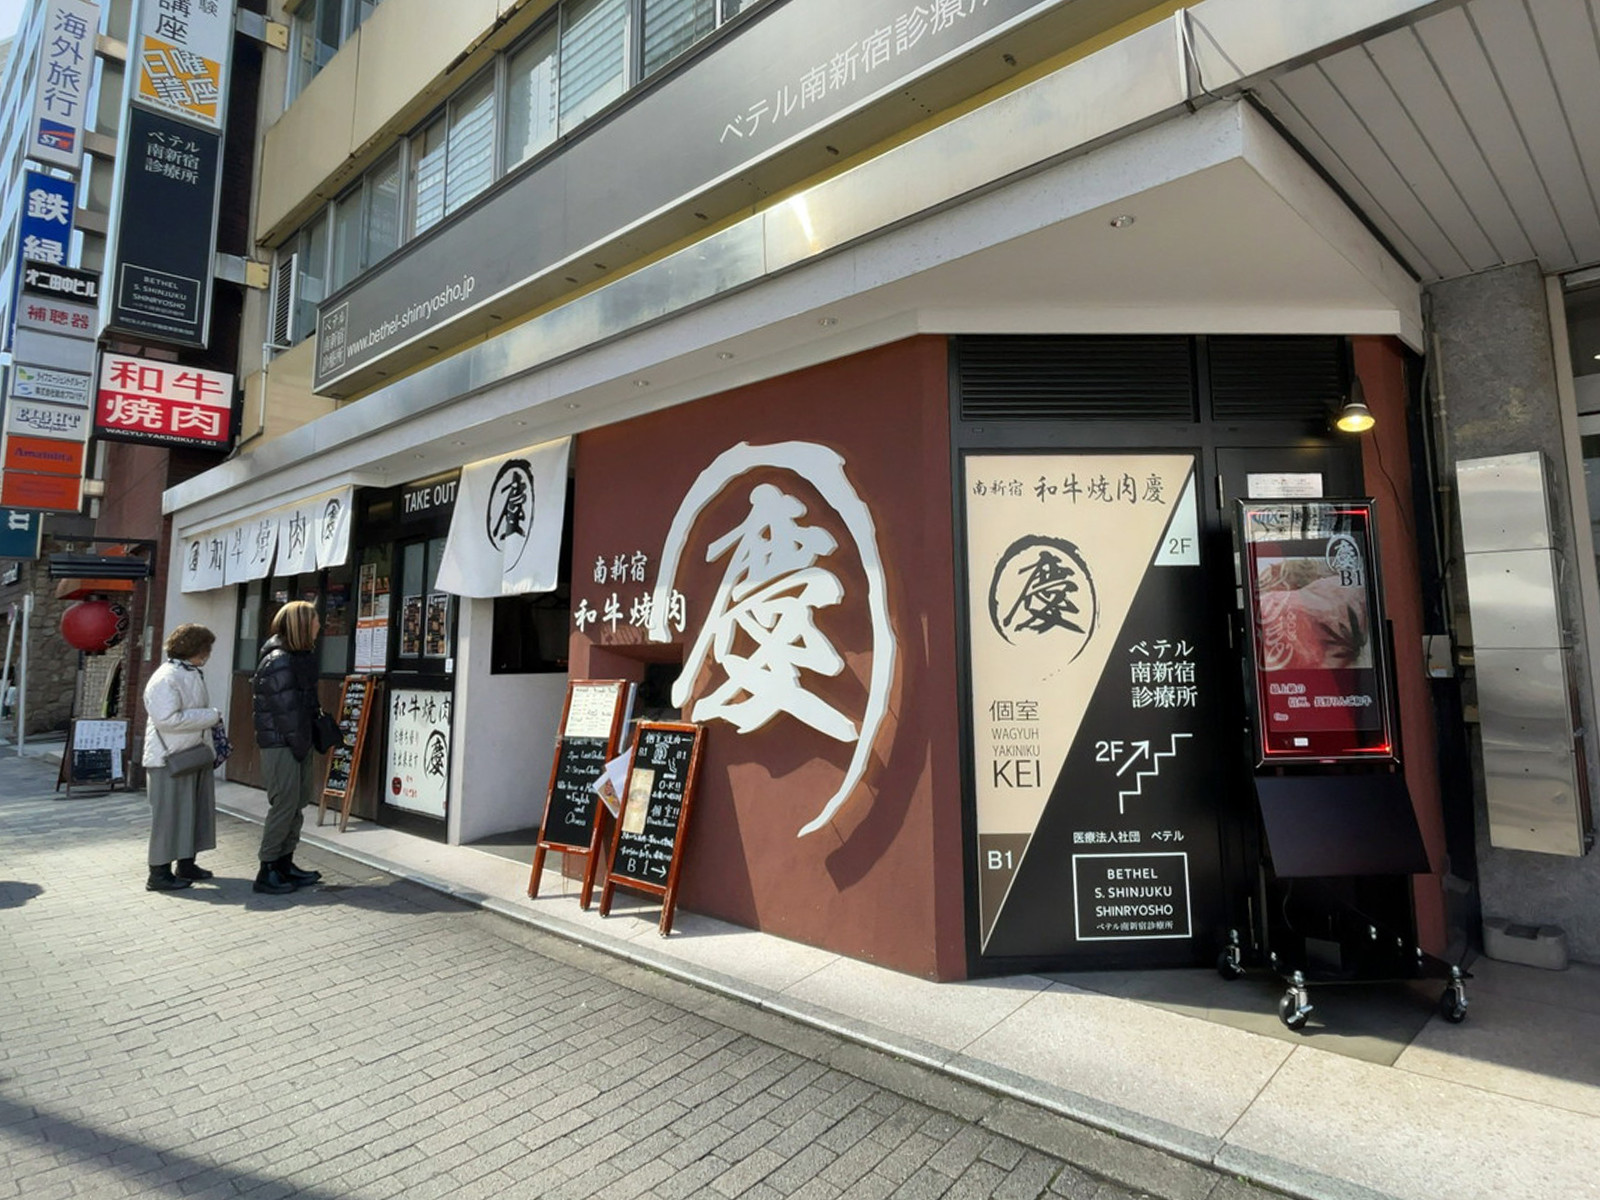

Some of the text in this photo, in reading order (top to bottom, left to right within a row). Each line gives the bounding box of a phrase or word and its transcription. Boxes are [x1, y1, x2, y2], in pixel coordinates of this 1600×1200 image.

[43, 8, 88, 117] 海外旅行
[720, 0, 990, 143] ベテル南新宿診療
[148, 131, 199, 152] ベテル
[147, 143, 199, 170] 南新宿
[145, 157, 199, 184] 診療所
[143, 276, 179, 290] BETHEL
[27, 304, 89, 329] 補聴器
[347, 275, 475, 358] www.bethel-shinryosho.jp
[110, 360, 224, 401] 和牛
[105, 395, 221, 436] 焼肉
[404, 481, 457, 513] TAKE OUT
[972, 479, 1023, 496] 南新宿
[1169, 538, 1192, 555] 2F
[594, 551, 647, 584] 南新宿
[1340, 570, 1362, 586] B1
[574, 588, 686, 633] 和牛焼肉
[1129, 639, 1194, 657] ベテル
[1130, 661, 1195, 683] 南新宿
[1131, 685, 1199, 709] 診療所
[393, 695, 451, 725] 和牛焼肉
[989, 700, 1040, 722] 個室
[992, 728, 1039, 741] WAGYUH
[993, 744, 1041, 758] YAKINIKU
[1095, 741, 1125, 762] 2F
[993, 760, 1041, 788] KEI
[1073, 830, 1185, 845] 医療法人社団 ベテル
[988, 850, 1013, 870] B1
[1107, 868, 1158, 880] BETHEL
[1095, 886, 1173, 899] S. SHINJUKU
[1095, 904, 1174, 918] SHINRYOSHO
